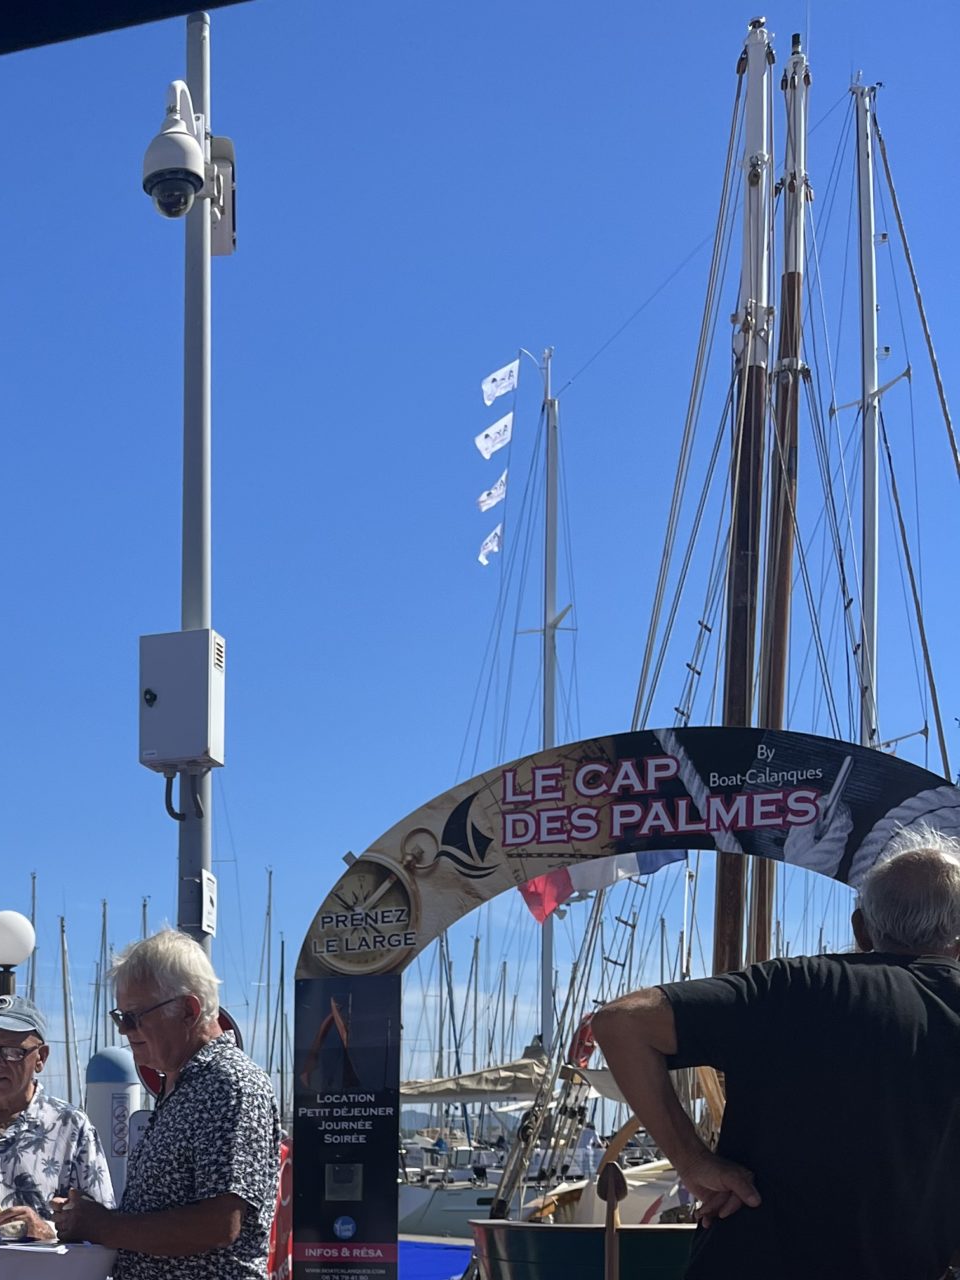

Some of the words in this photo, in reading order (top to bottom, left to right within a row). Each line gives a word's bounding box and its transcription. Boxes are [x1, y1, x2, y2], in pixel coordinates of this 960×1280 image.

[757, 744, 776, 762] By
[503, 765, 563, 804] LE
[574, 757, 679, 797] CAP
[709, 767, 823, 788] Boat-Calanques
[503, 806, 599, 846] DES
[611, 790, 818, 838] PALMES
[321, 908, 408, 930] PRENEZ
[313, 939, 338, 954] LE
[345, 931, 417, 952] LARGE
[316, 1094, 376, 1103] LOCATION
[298, 1107, 331, 1117] PETIT
[317, 1119, 373, 1130] JOURNÉE
[323, 1132, 367, 1143] SOIRÉE
[305, 1248, 339, 1257] INFOS
[341, 1247, 350, 1257] &
[353, 1247, 383, 1258] RÉSA
